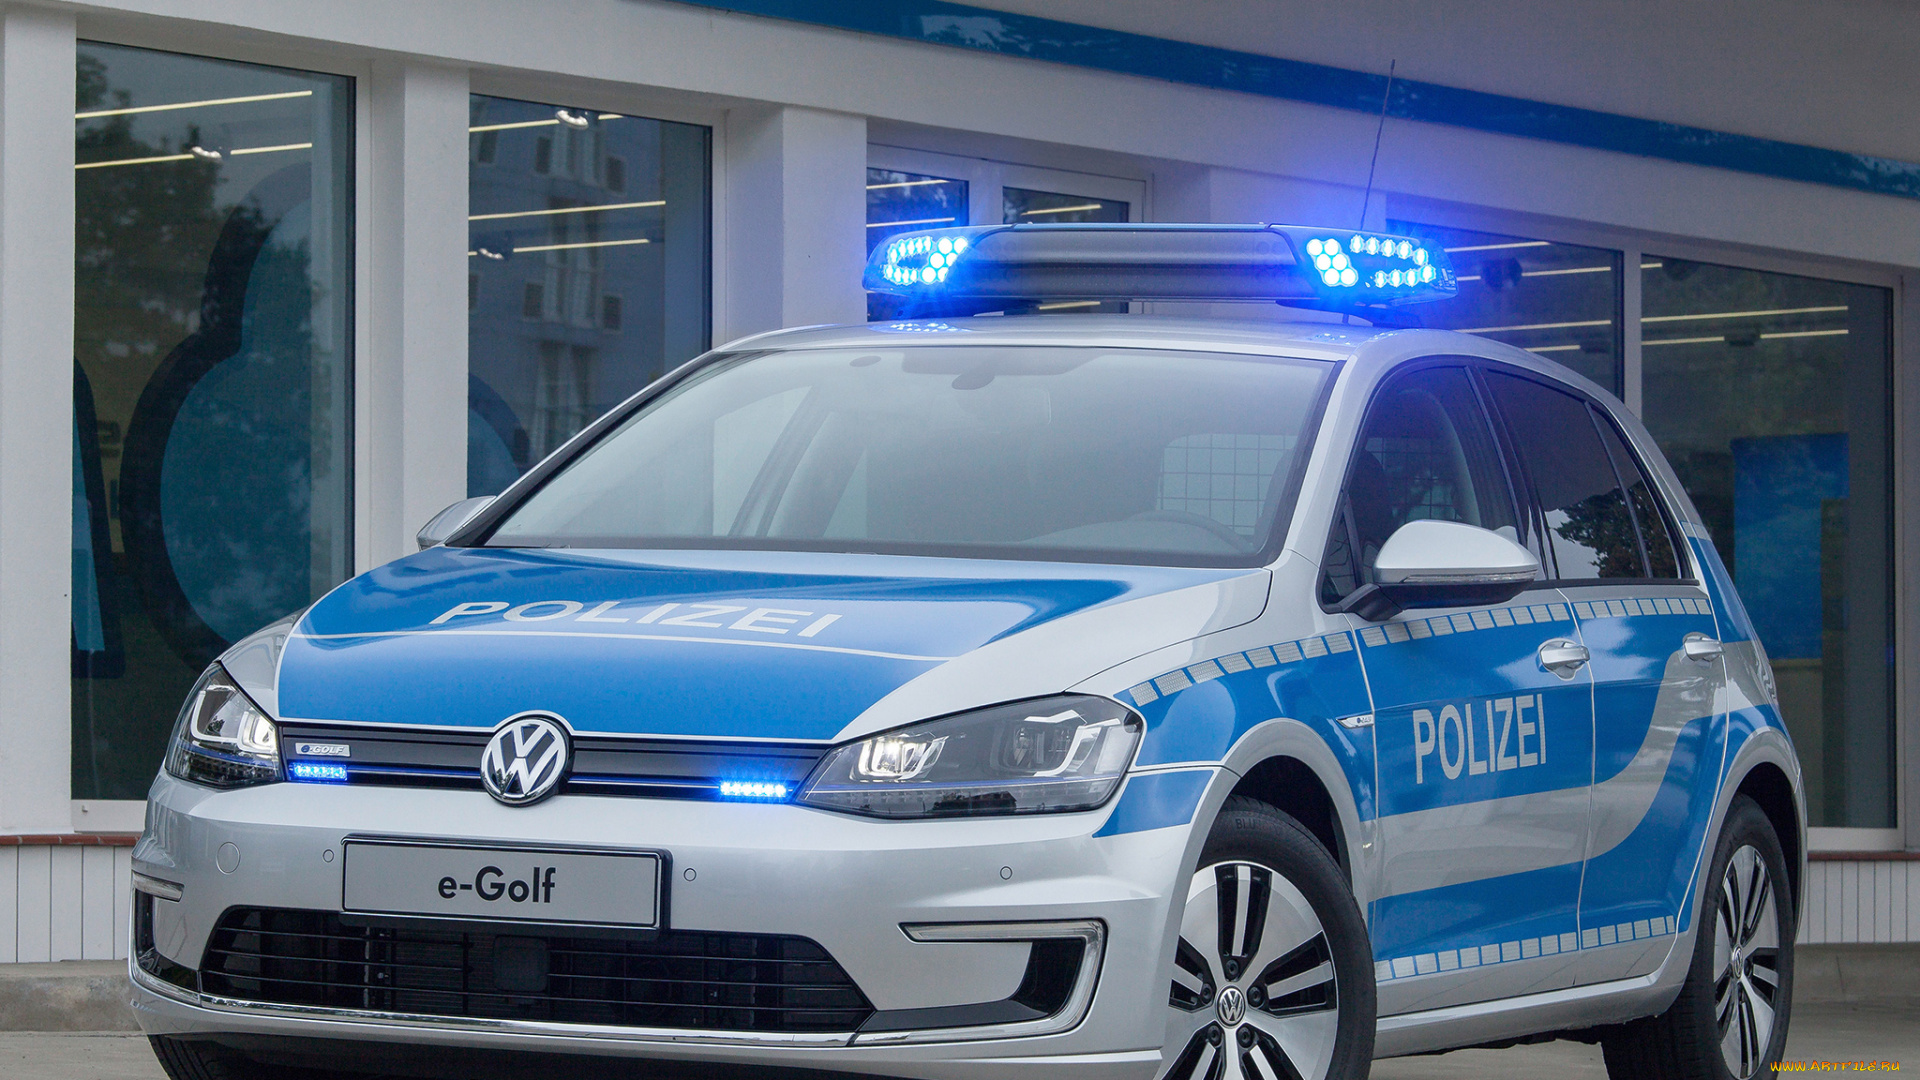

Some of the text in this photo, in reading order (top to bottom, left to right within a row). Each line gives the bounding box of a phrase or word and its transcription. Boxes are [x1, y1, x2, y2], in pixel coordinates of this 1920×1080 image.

[429, 601, 842, 637] POLIZEI
[481, 719, 566, 798] VW
[1413, 694, 1546, 784] POLIZEI
[438, 866, 556, 903] e-Golf
